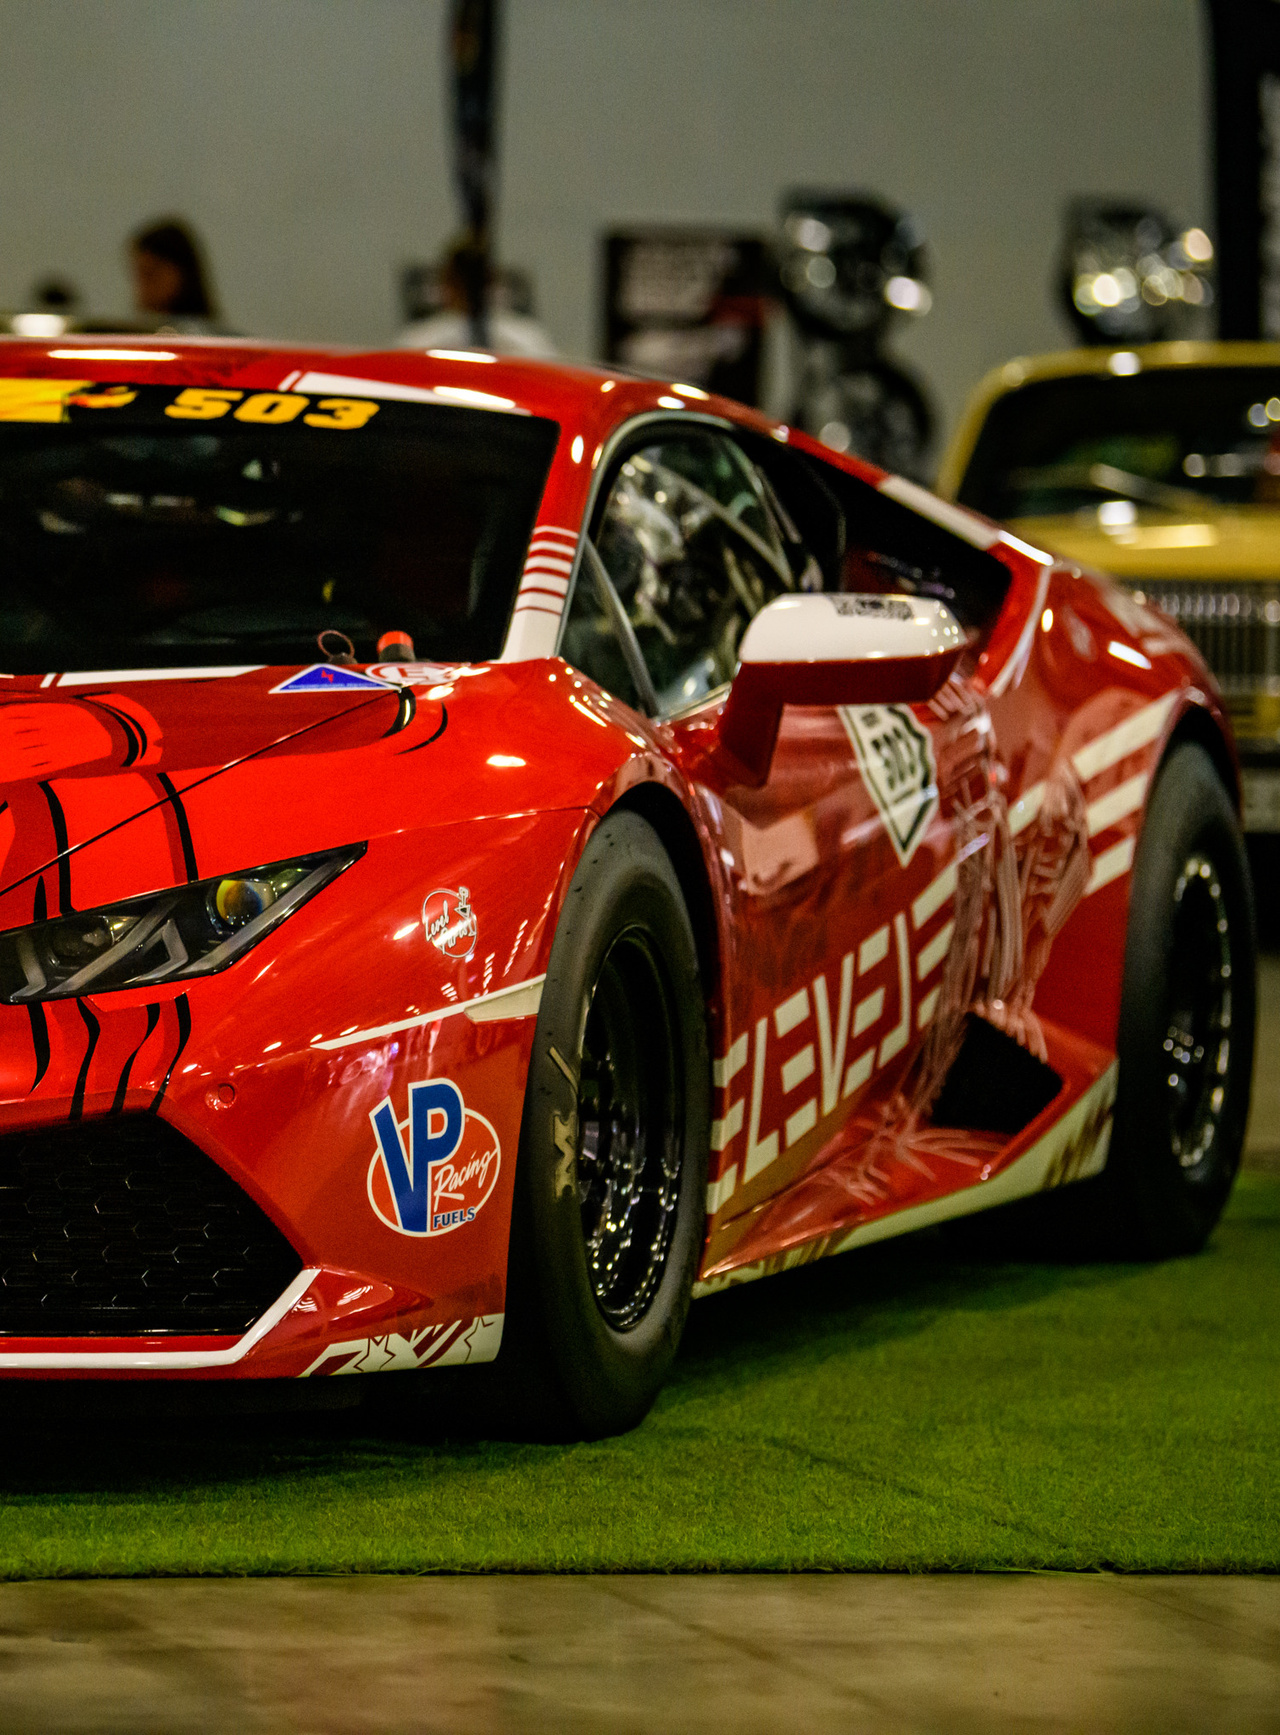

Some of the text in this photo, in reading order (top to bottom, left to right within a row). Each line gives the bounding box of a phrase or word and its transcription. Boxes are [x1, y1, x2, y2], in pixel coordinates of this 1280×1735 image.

[164, 387, 381, 430] 503
[370, 1078, 464, 1233] VP
[433, 1151, 497, 1213] Racing
[432, 1207, 476, 1230] FUELS
